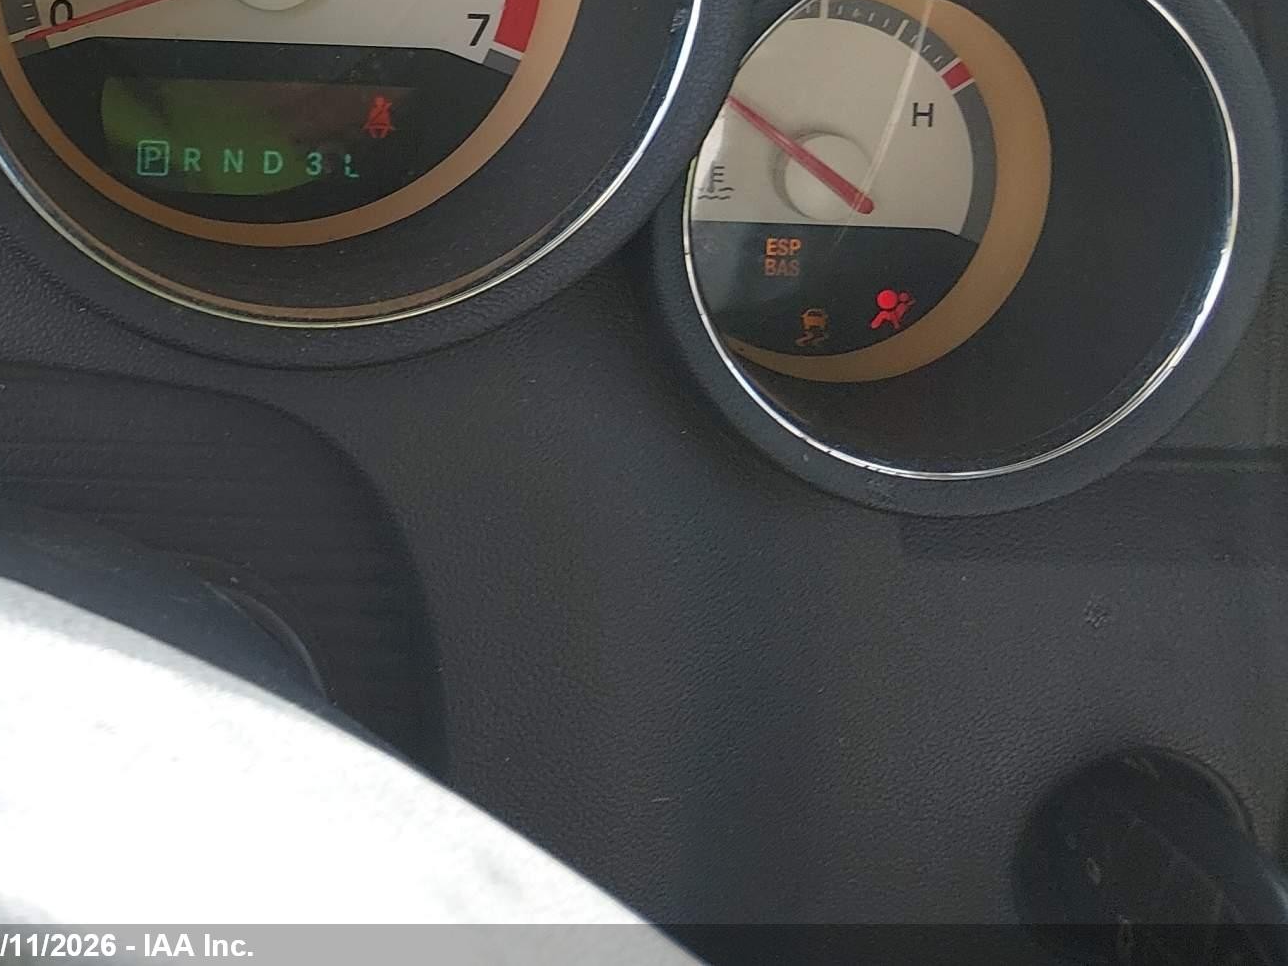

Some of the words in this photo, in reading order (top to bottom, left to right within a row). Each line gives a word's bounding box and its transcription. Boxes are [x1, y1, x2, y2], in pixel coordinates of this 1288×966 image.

[467, 13, 491, 47] 7
[912, 102, 934, 127] H
[144, 148, 161, 170] P
[183, 148, 201, 172] R
[223, 148, 244, 173] N
[263, 151, 283, 174] D
[305, 152, 323, 176] 3
[344, 154, 360, 178] L
[765, 238, 802, 256] ESP
[764, 260, 801, 277] BAS
